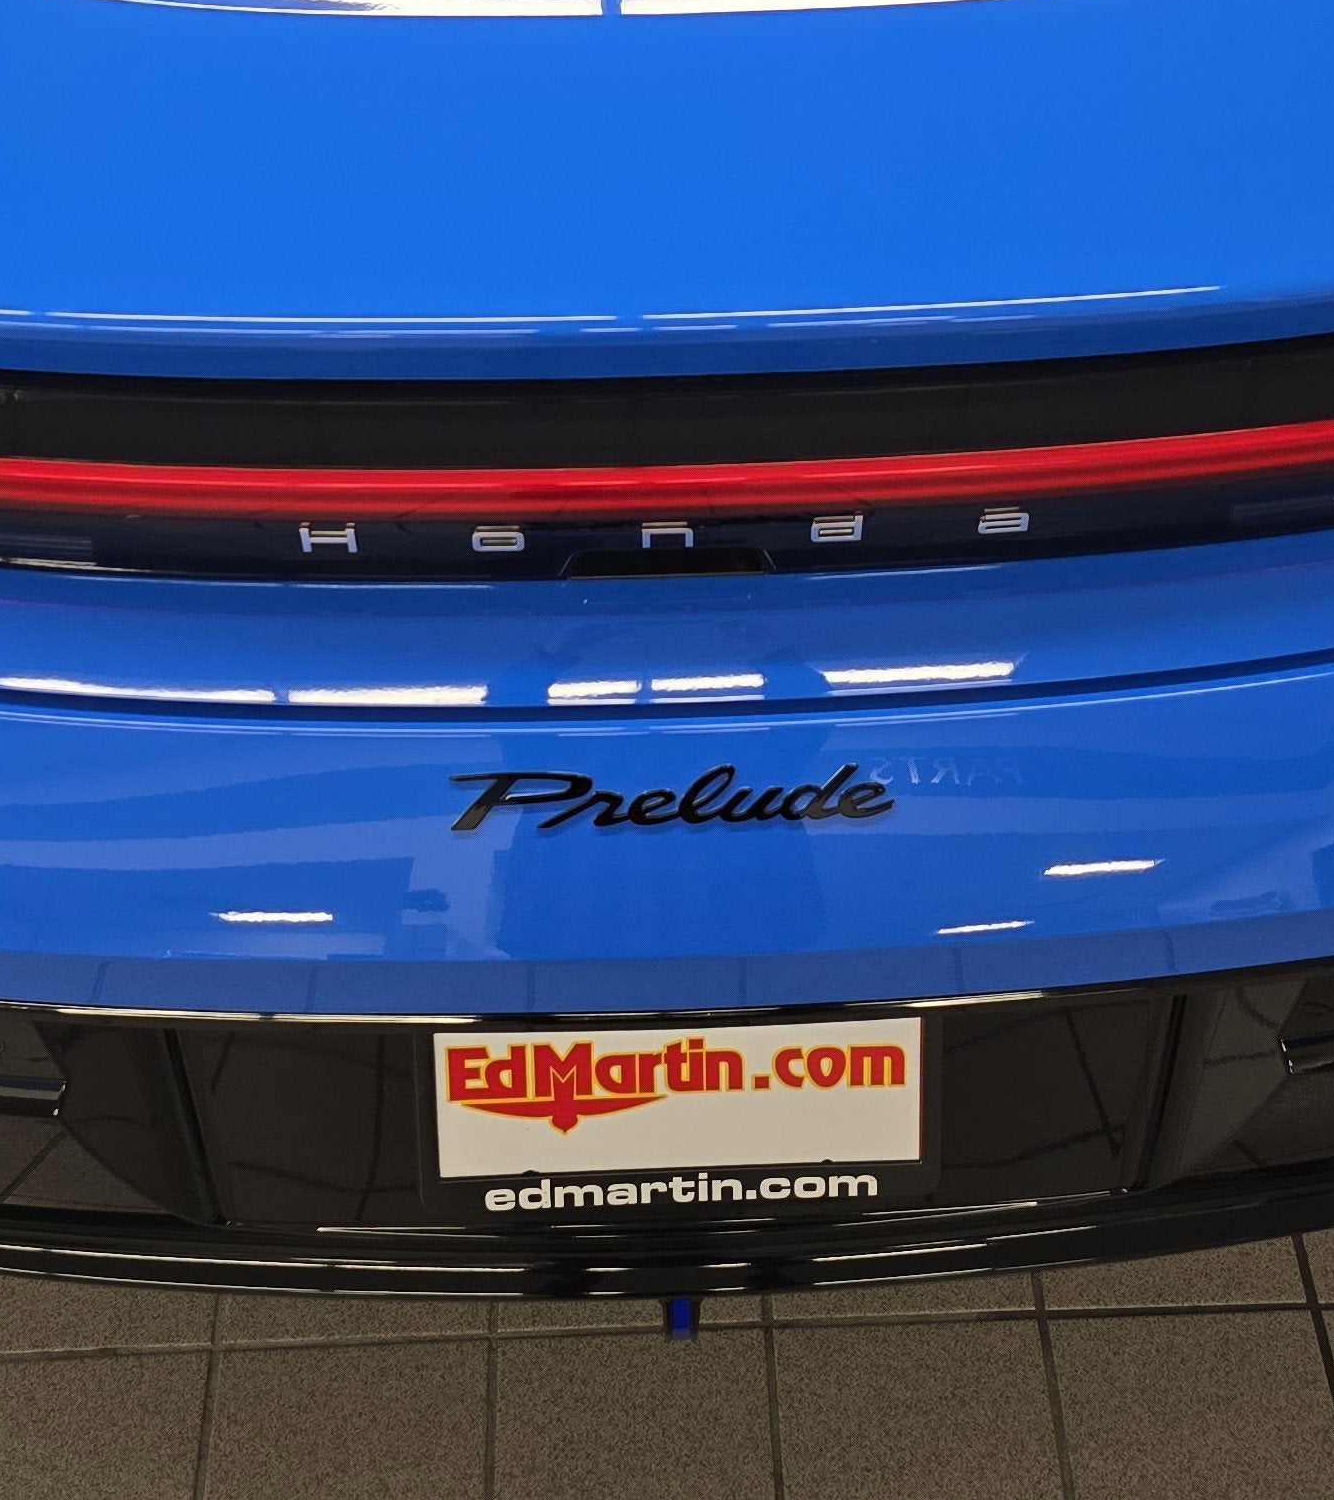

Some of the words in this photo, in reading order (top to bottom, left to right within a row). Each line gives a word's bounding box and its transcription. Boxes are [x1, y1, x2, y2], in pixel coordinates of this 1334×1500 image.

[449, 764, 895, 831] Prelude
[445, 1036, 905, 1104] EdMartin.com
[484, 1171, 879, 1212] edmartin.com
